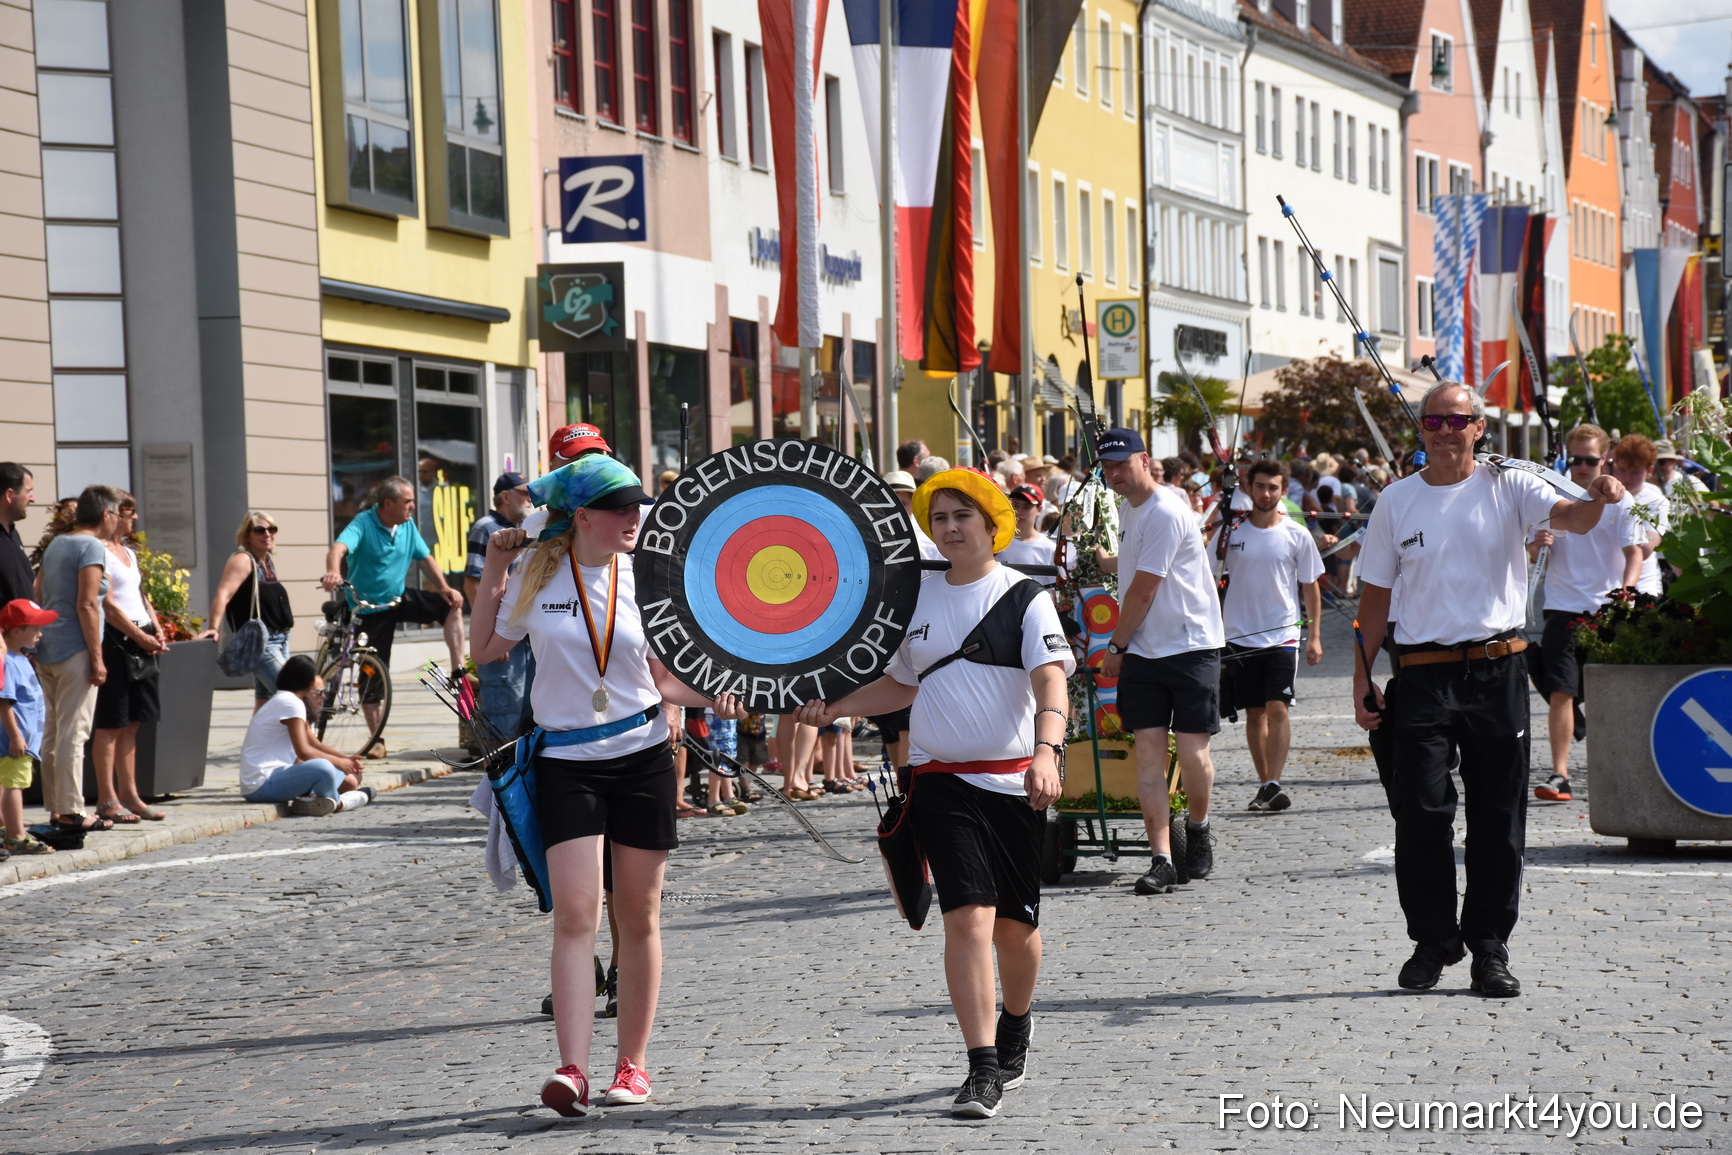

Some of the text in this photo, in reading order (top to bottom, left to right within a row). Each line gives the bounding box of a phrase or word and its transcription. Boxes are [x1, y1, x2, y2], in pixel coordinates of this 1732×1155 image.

[563, 286, 593, 322] G2
[1112, 311, 1125, 330] H
[433, 485, 470, 575] SALE
[642, 440, 915, 566] BOGENSCHÜTZEN
[642, 597, 827, 709] NEUMARKT
[846, 602, 903, 674] OPF
[759, 782, 789, 806] HOYT
